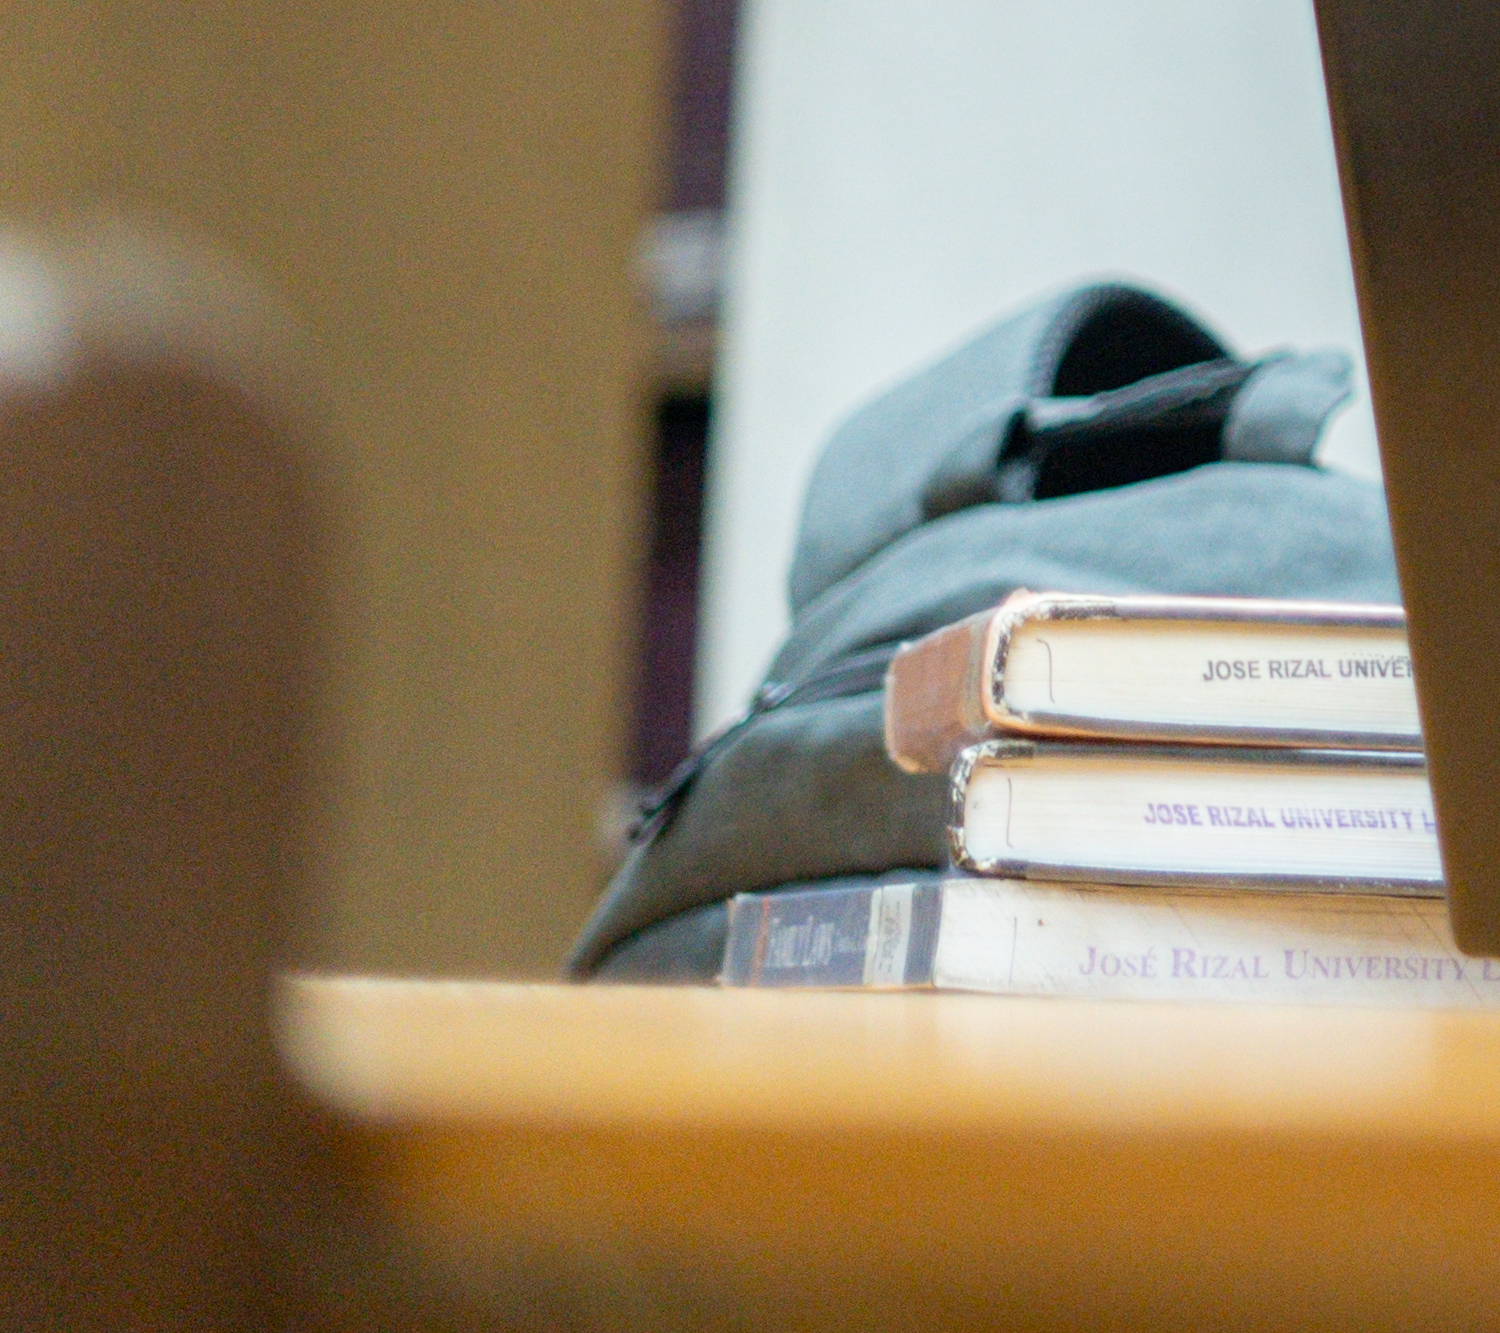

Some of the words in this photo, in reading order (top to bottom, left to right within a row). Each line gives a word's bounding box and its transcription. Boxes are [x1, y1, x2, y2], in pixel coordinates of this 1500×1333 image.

[1203, 660, 1261, 681] JOSE
[1269, 659, 1331, 679] RIZAL
[1144, 802, 1203, 827] JOSE
[1206, 805, 1275, 829] RIZAL
[1280, 807, 1415, 831] UNIVERSITY
[1171, 948, 1271, 980] RIZAL
[1283, 948, 1470, 981] UNIVERSITY
